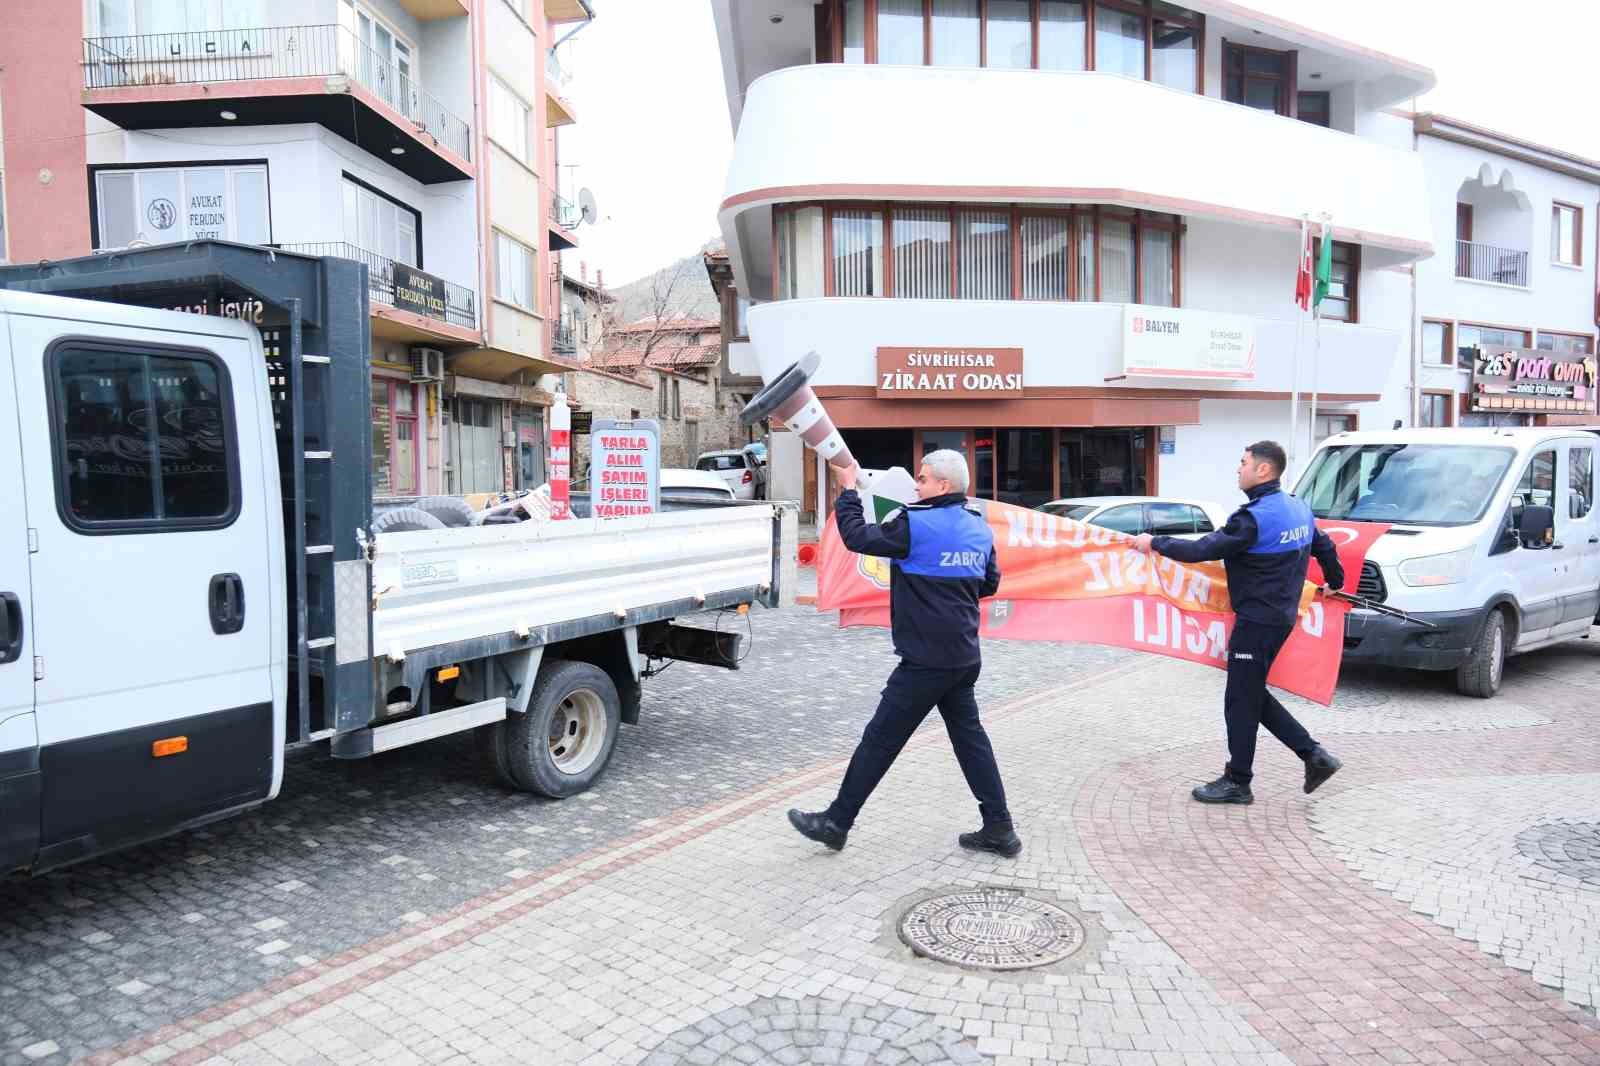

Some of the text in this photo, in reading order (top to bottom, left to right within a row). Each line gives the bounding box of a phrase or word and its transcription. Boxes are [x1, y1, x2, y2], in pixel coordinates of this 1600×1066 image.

[190, 195, 222, 208] AVUKAT
[1145, 319, 1180, 334] BALYEM
[907, 350, 995, 367] SİVRİHİSAR
[881, 369, 1023, 391] ZİRAAT ODASI
[601, 437, 648, 449] TARLA
[607, 454, 641, 466] ALIM
[602, 471, 647, 483] SATIM
